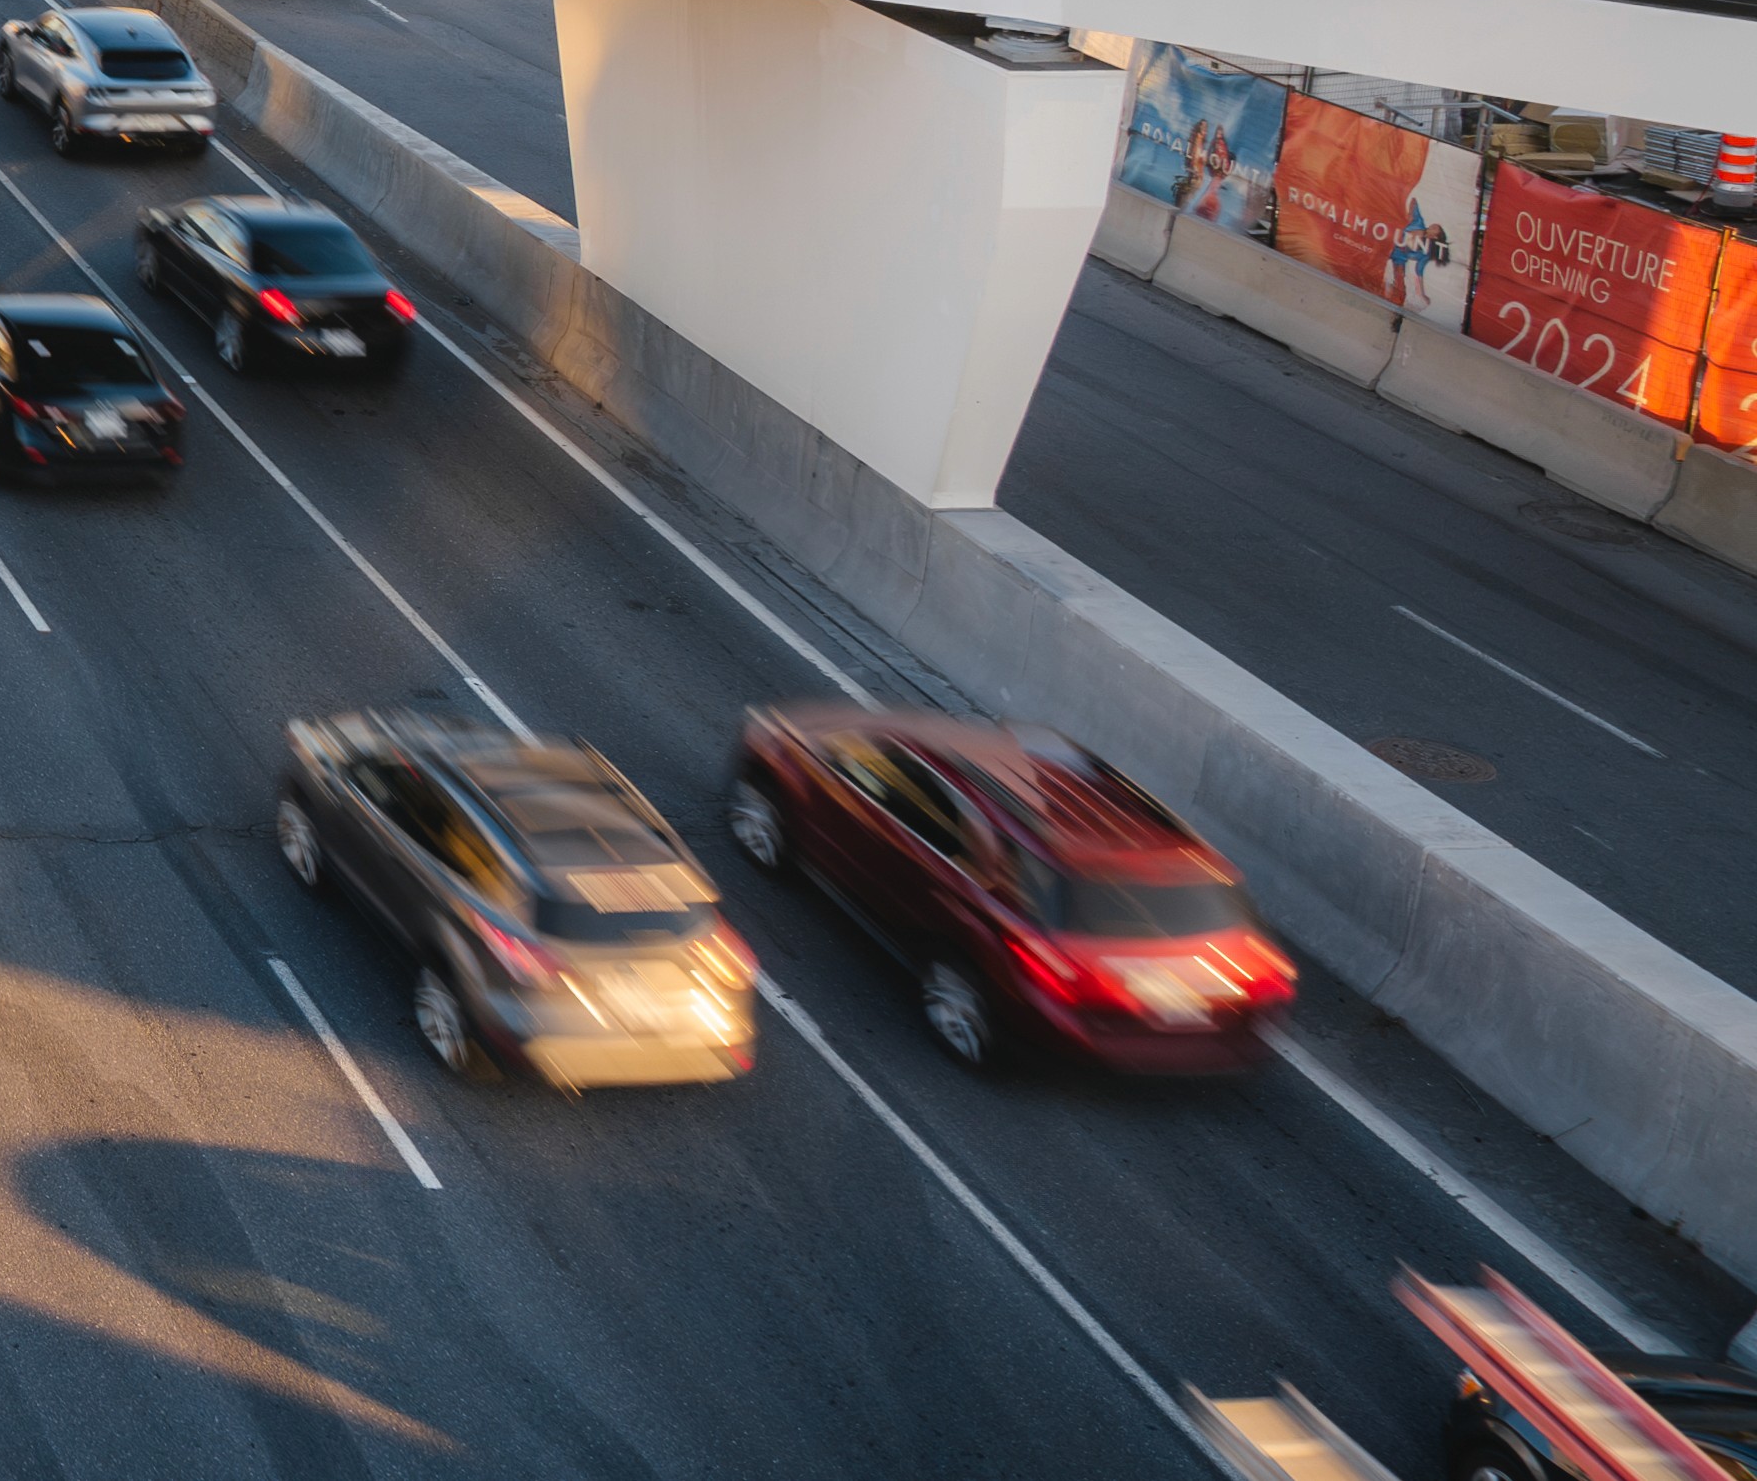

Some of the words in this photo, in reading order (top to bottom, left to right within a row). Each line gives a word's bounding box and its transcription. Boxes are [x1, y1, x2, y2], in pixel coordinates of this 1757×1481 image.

[1288, 186, 1449, 261] ROYALMOUNT
[1516, 211, 1677, 293] OUVERTURE
[1510, 248, 1611, 304] OPENING
[1498, 300, 1653, 414] 2024
